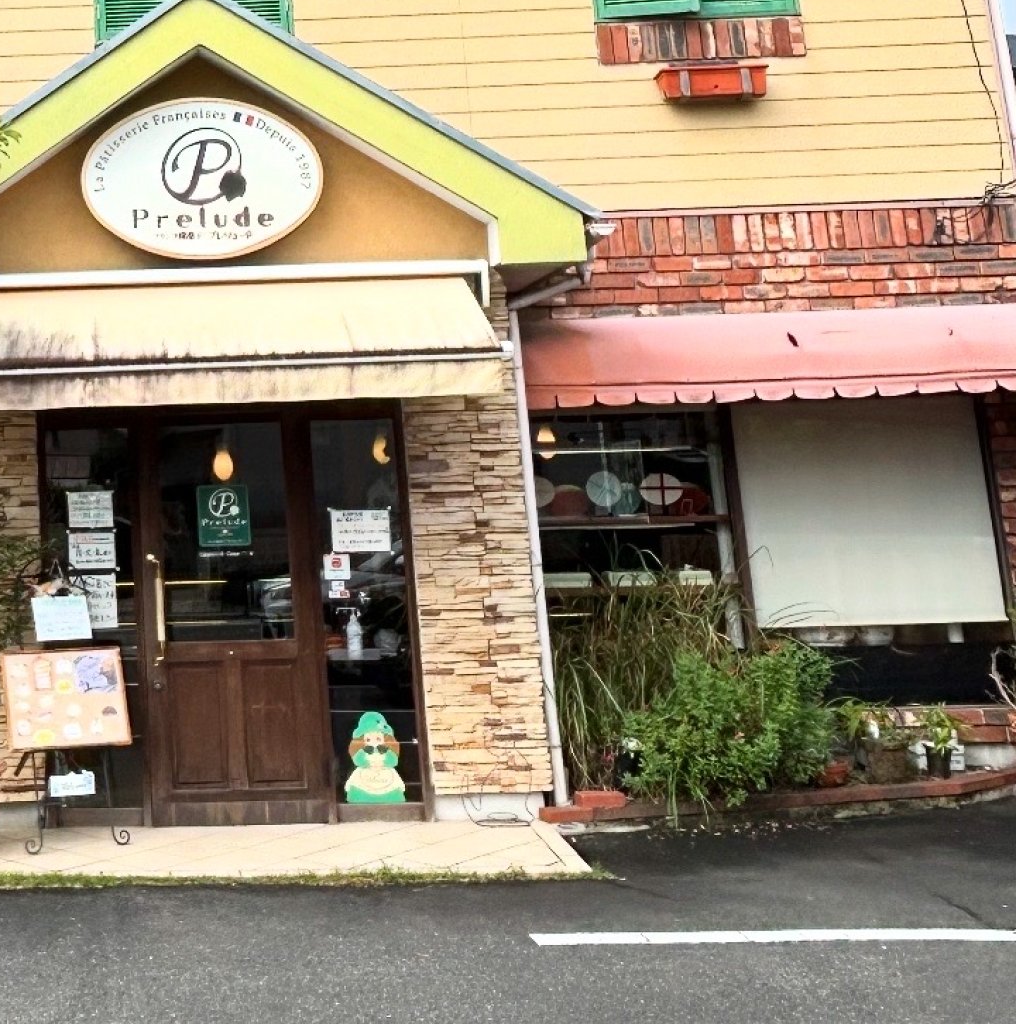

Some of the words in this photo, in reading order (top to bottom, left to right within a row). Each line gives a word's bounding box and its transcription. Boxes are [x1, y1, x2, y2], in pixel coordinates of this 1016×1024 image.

[94, 176, 105, 192] La
[152, 107, 227, 126] Françaises
[255, 118, 297, 152] Depuis
[132, 205, 275, 229] Prelude
[201, 518, 247, 527] Prelude
